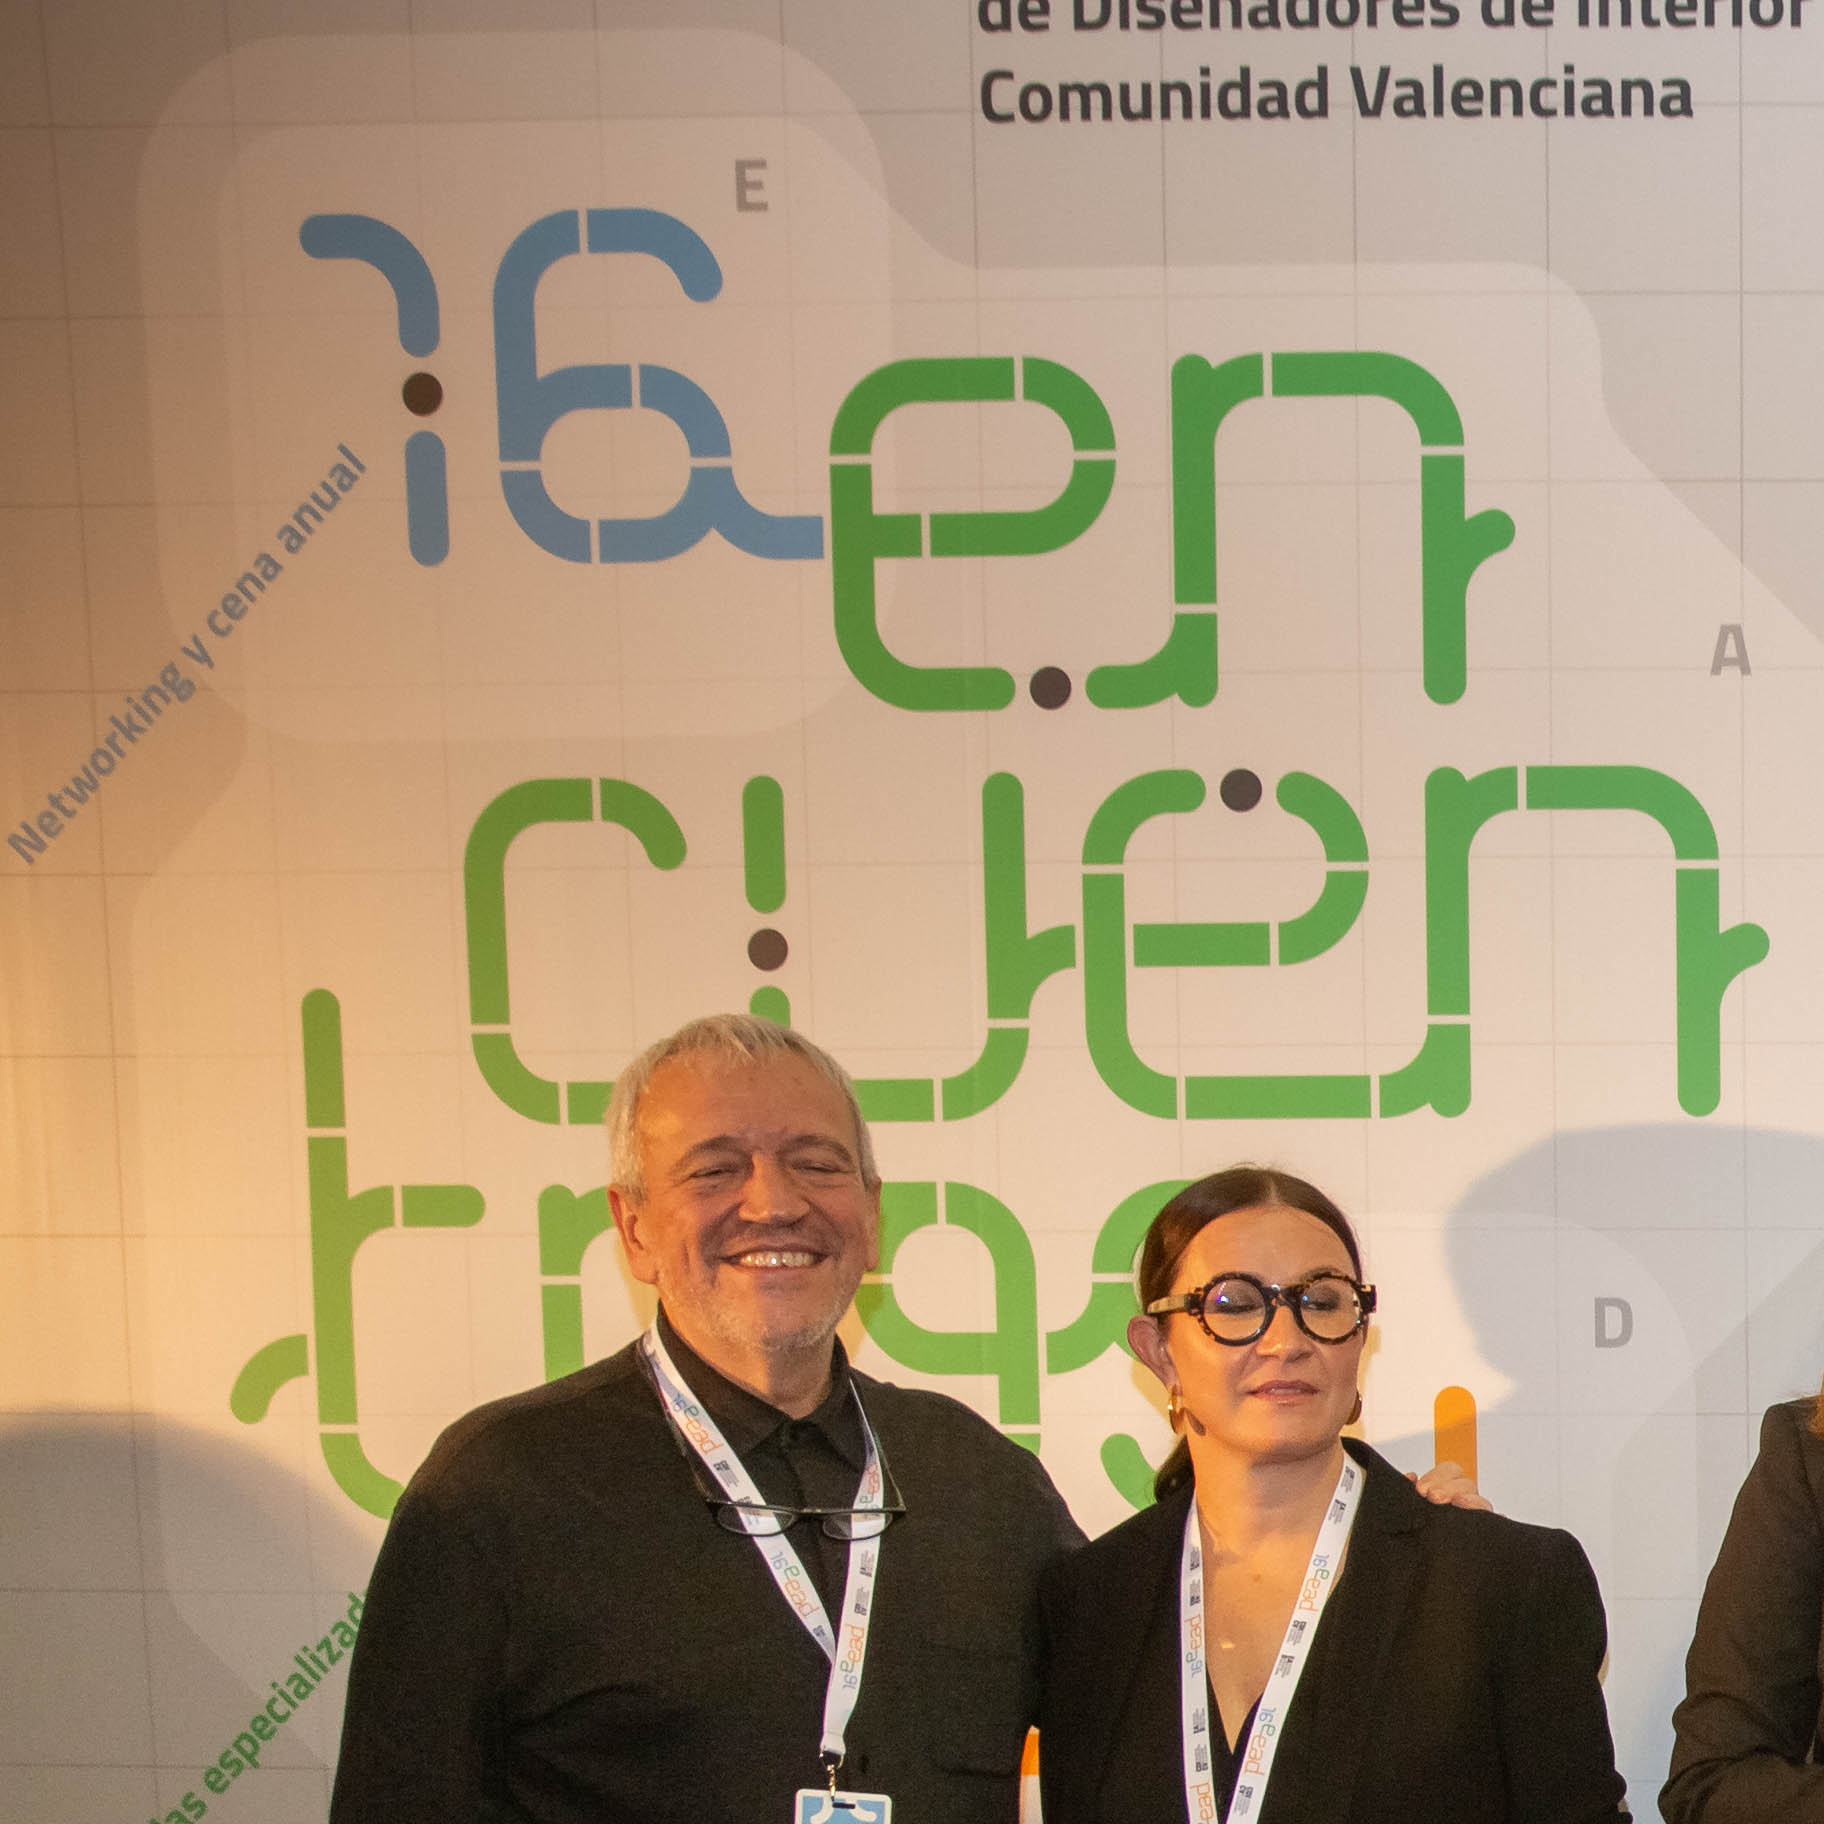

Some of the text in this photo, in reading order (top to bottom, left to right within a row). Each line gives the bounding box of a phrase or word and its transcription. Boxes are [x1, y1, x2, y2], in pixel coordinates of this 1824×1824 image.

[980, 64, 1694, 123] Comunidad Valenciana
[735, 158, 768, 213] E
[7, 442, 367, 865] Networking y cena anual
[1709, 623, 1752, 676] A
[1593, 1296, 1633, 1349] D
[203, 1589, 367, 1795] especializad
